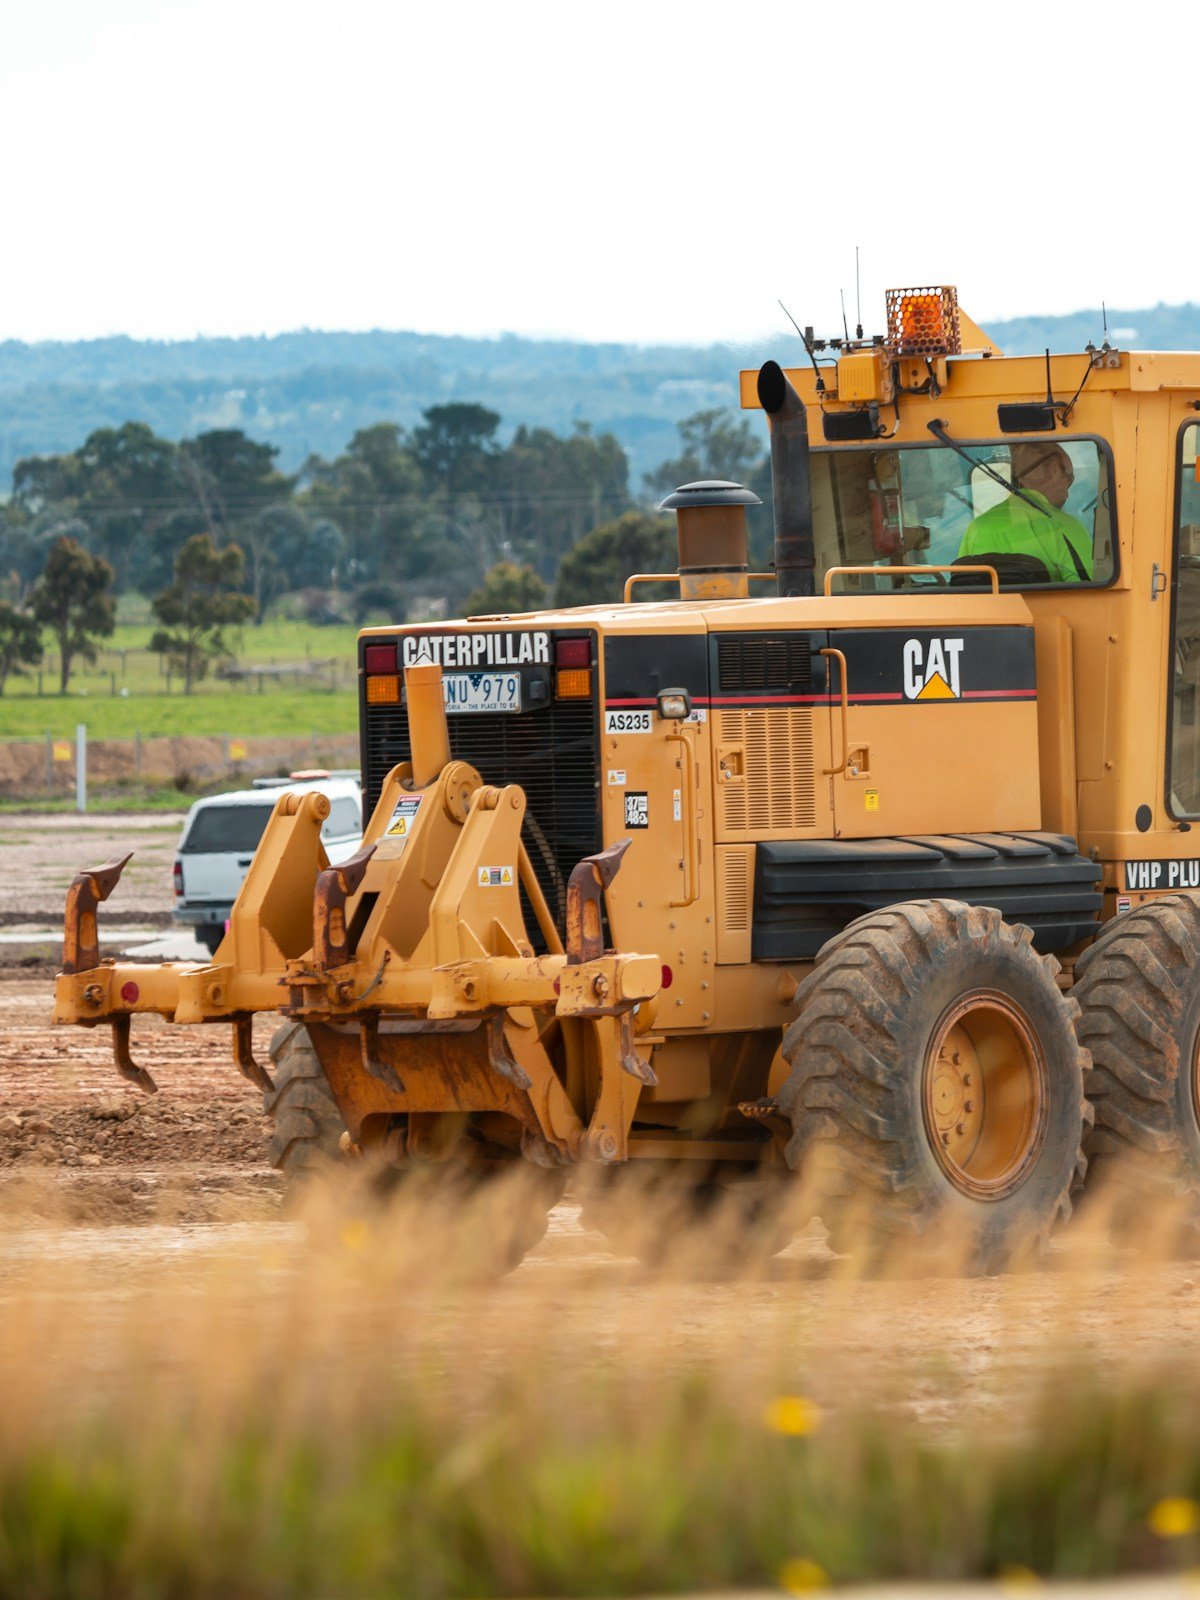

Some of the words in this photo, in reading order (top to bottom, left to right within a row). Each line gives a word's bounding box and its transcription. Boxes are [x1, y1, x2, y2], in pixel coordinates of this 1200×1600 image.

[402, 632, 549, 667] CATERPILLAR
[903, 638, 964, 700] CAT
[483, 678, 516, 702] 979
[608, 714, 650, 731] AS235
[1126, 861, 1162, 889] VHP
